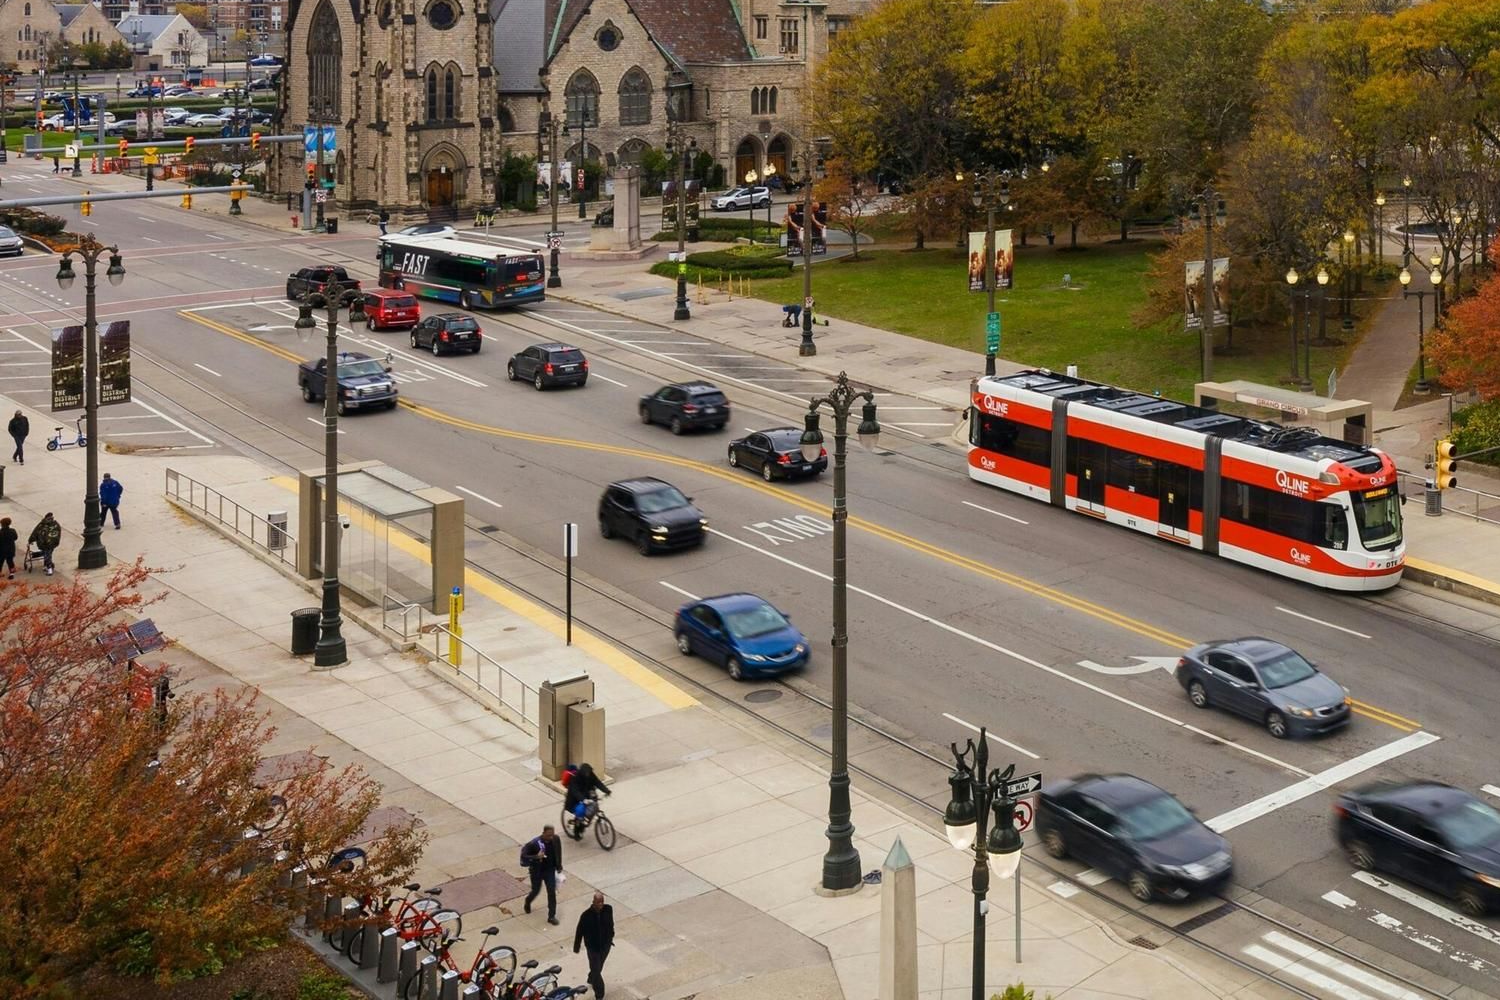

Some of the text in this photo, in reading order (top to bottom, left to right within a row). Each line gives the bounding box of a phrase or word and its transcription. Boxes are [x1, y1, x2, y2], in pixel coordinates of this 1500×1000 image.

[401, 252, 430, 276] FAST
[54, 394, 81, 402] DISTRICT
[102, 388, 128, 397] DISTRICT
[984, 395, 1008, 414] QLINE
[1256, 399, 1308, 415] GRAND CIRCUS
[981, 456, 996, 469] QLINE
[1275, 470, 1309, 493] QLINE
[1282, 488, 1303, 498] DETROIT
[742, 515, 834, 545] ONLY
[1290, 547, 1311, 562] QLINE
[1015, 783, 1029, 791] WAY
